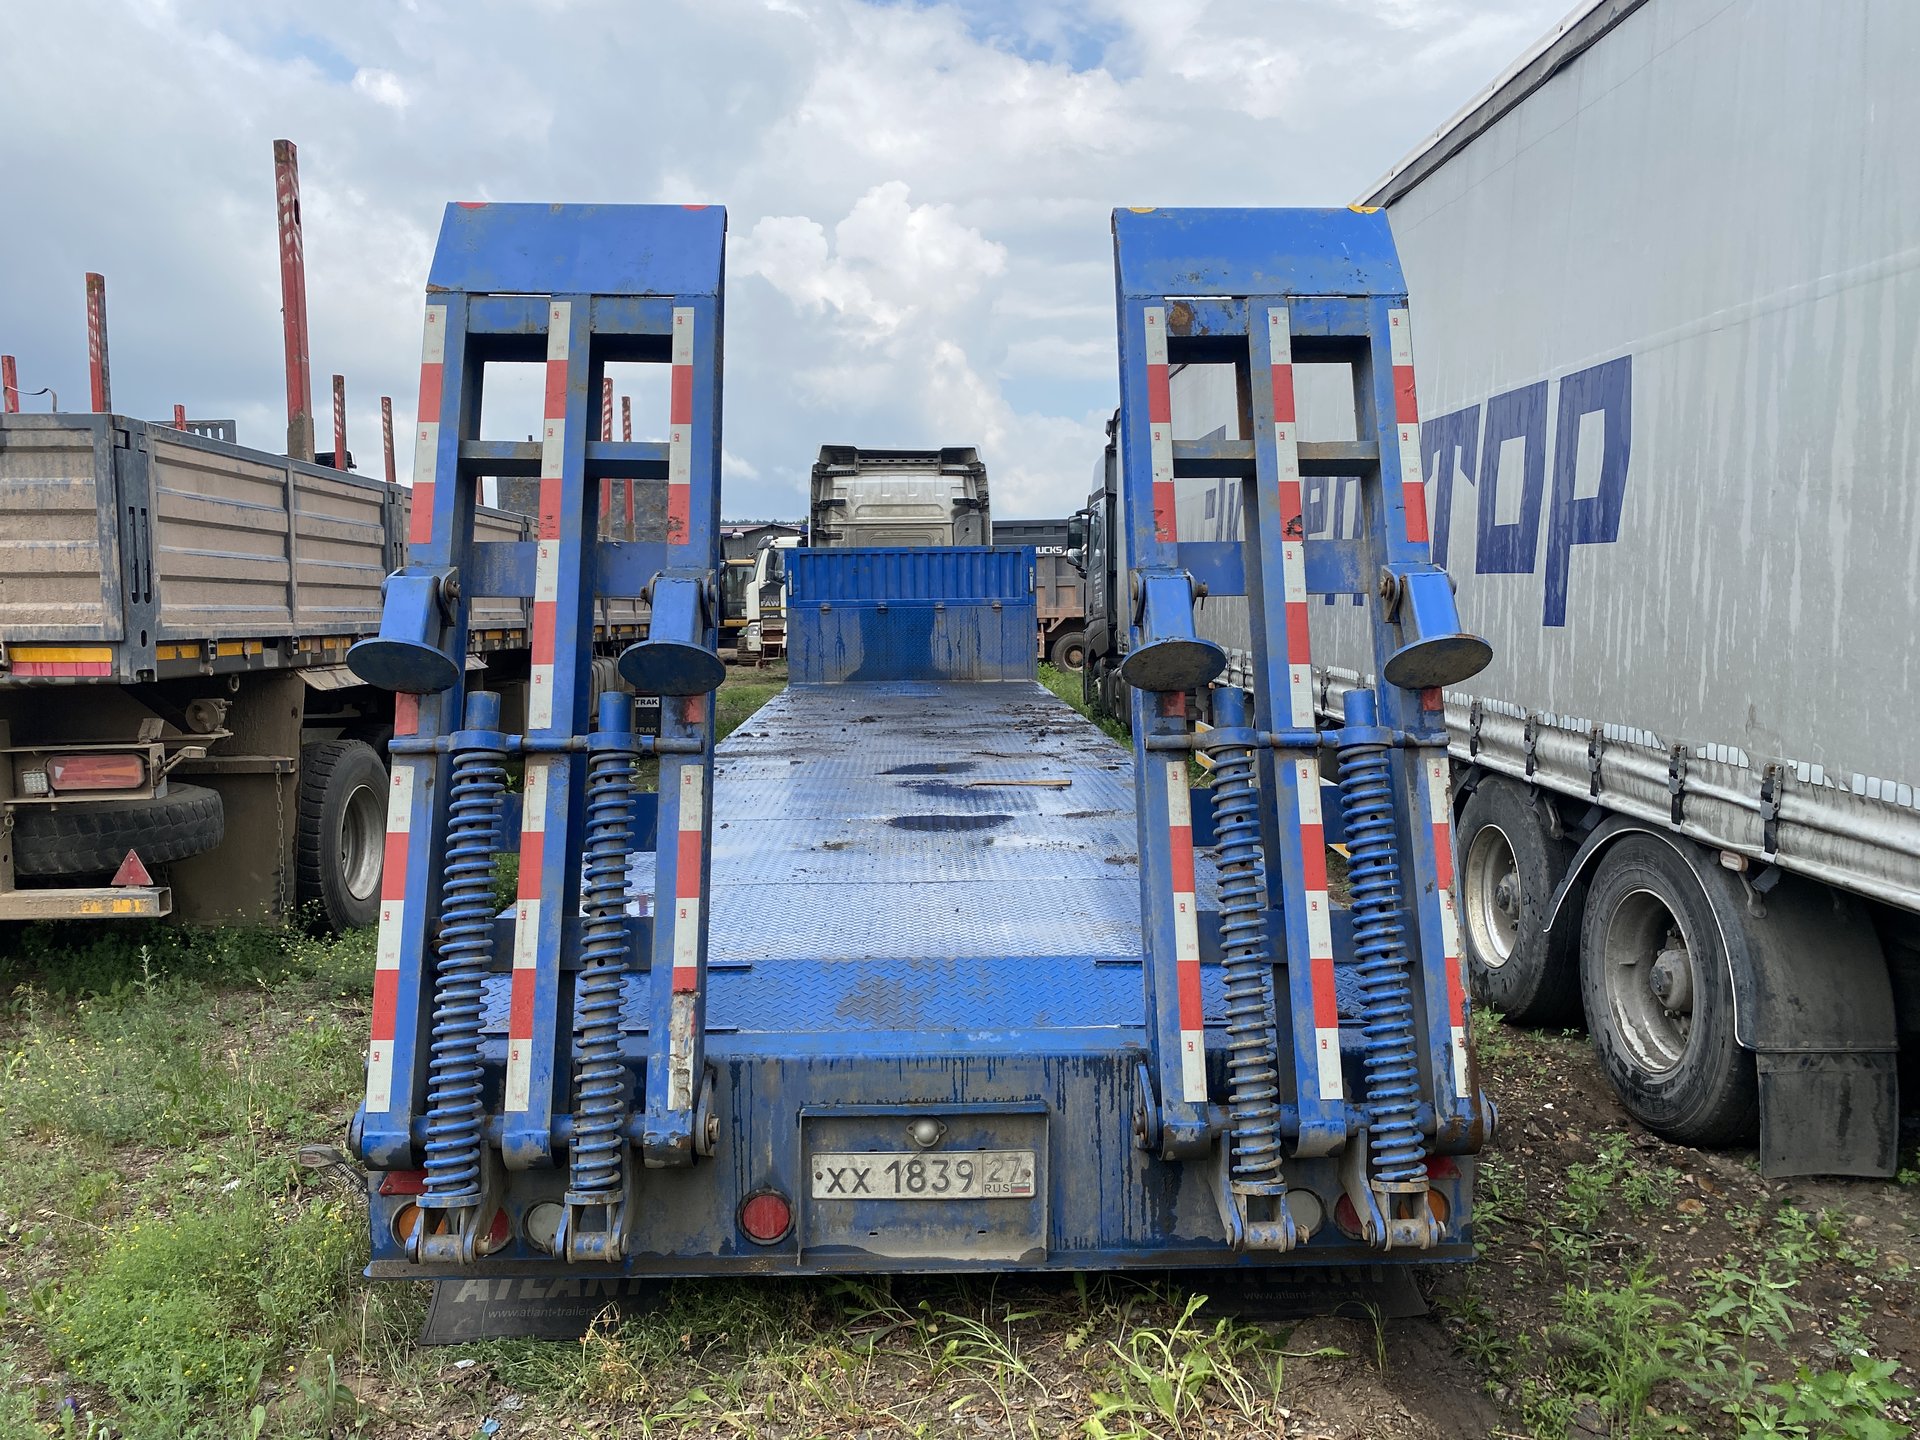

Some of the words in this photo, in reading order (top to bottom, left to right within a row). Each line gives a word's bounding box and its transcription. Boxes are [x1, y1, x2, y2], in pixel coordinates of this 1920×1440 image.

[827, 1167, 871, 1194] XX
[884, 1160, 975, 1194] 1839
[986, 1157, 1023, 1183] 27
[984, 1183, 1011, 1194] RUS
